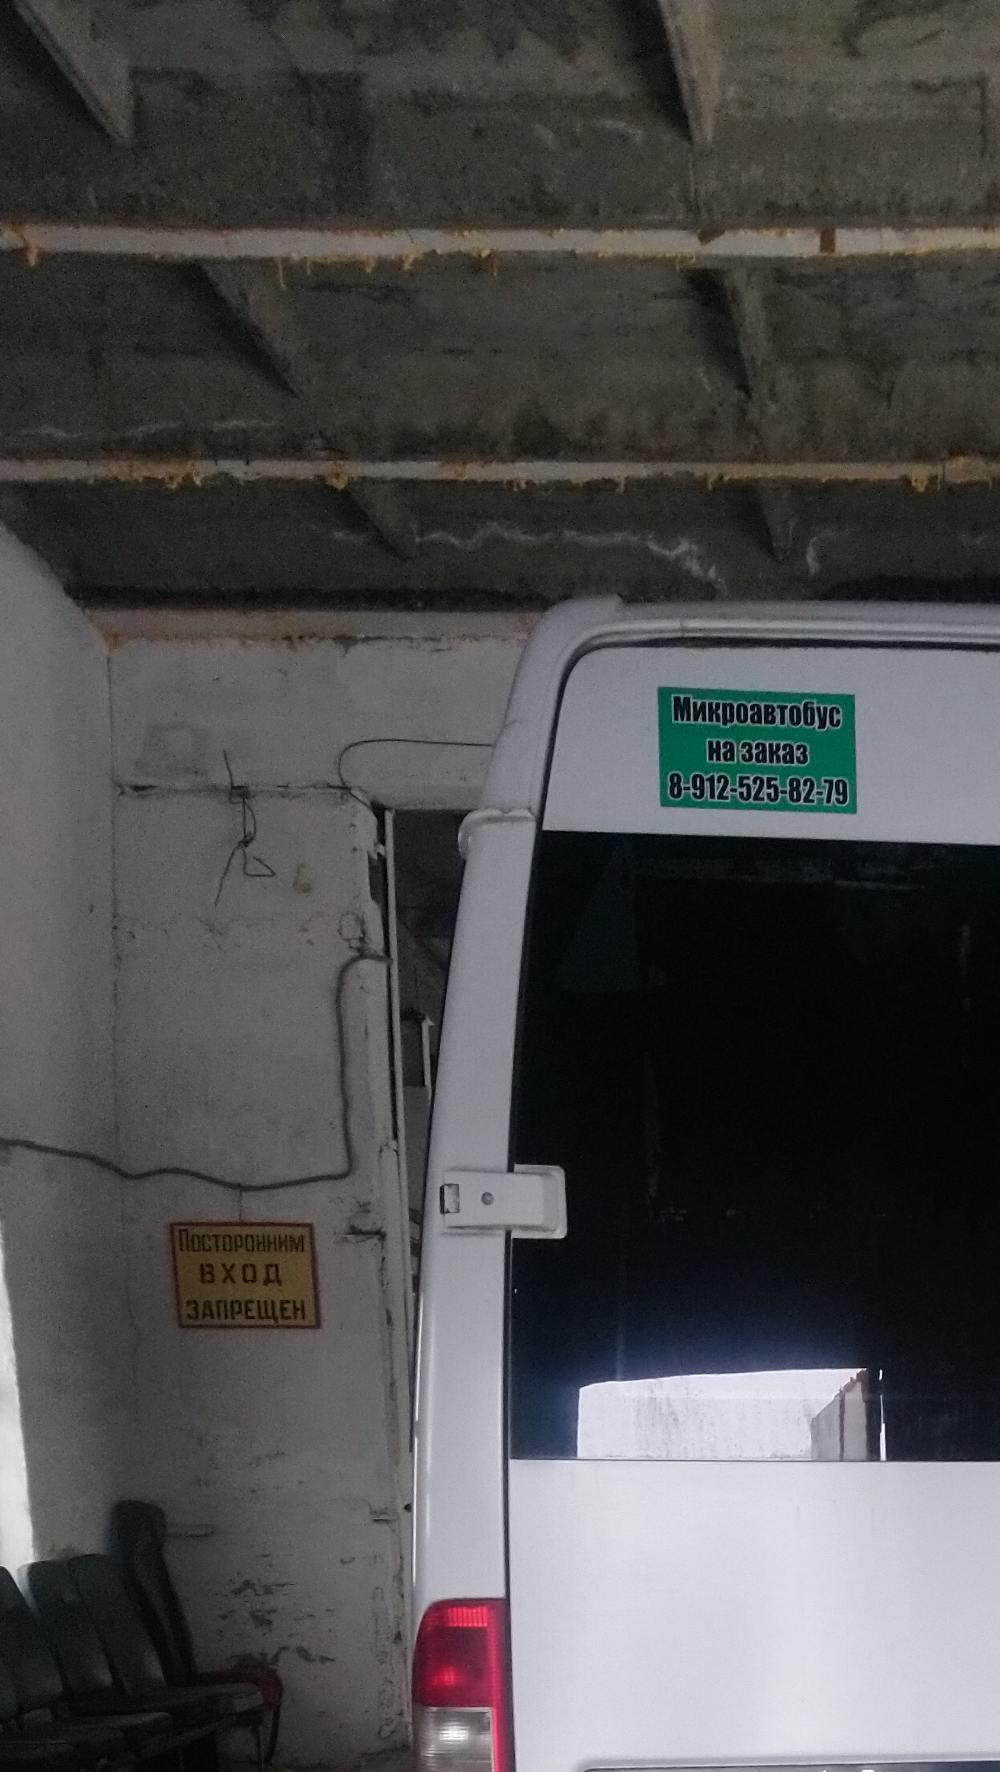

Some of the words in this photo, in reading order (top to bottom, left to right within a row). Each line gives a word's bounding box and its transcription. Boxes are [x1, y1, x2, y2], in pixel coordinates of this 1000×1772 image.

[672, 695, 842, 730] Микроавтобус
[707, 740, 735, 763] на
[741, 742, 808, 765] заказ
[668, 773, 848, 805] 8-912-525-82-79
[200, 1263, 282, 1286] ВХОД
[186, 1300, 306, 1323] ЗАПРЕЩЕН
